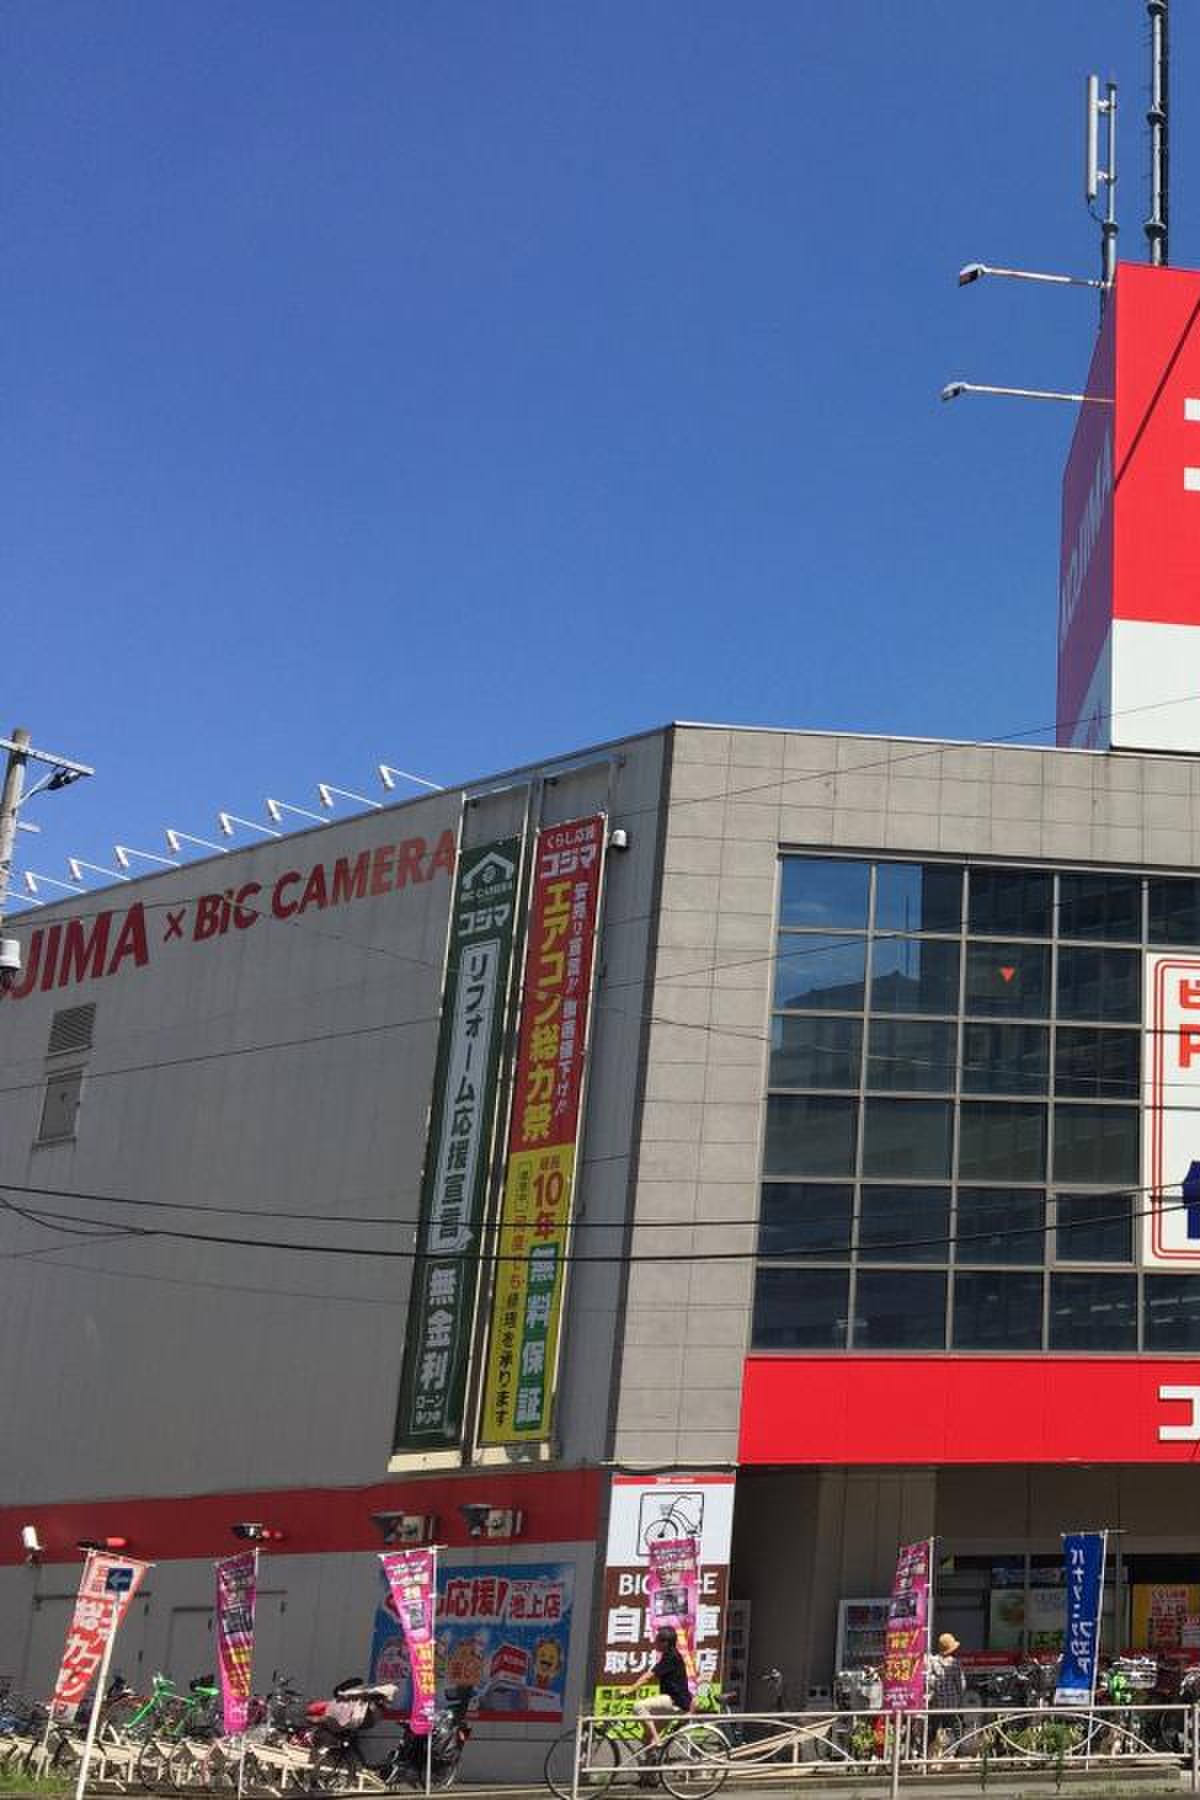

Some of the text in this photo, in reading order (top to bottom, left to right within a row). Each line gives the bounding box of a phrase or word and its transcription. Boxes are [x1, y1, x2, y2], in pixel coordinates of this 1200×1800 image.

[541, 844, 597, 880] コジマ
[0, 902, 151, 1000] JIMA
[271, 829, 456, 920] CAMERA
[458, 902, 511, 937] コジマ
[420, 1267, 457, 1390] 無金利
[607, 1605, 721, 1645] 自車
[604, 1649, 718, 1675] 取り店
